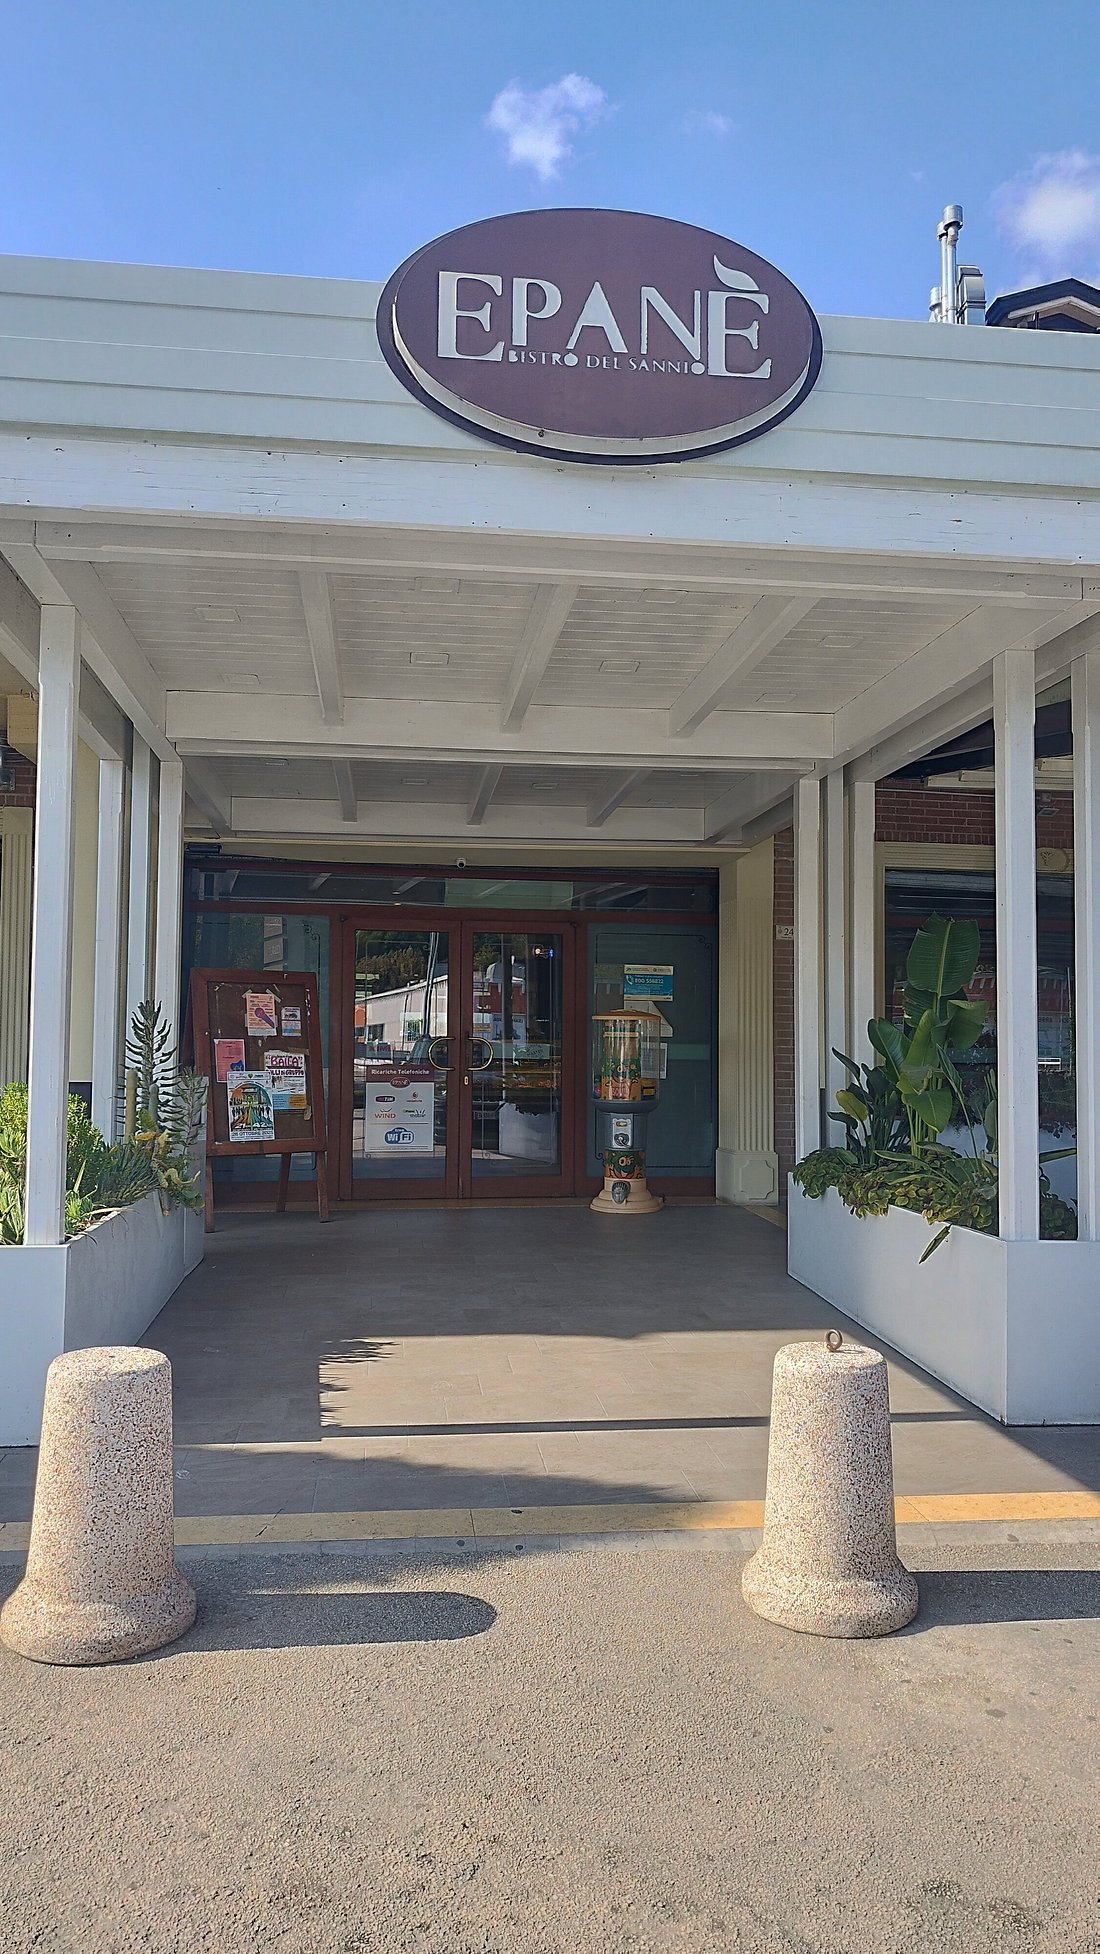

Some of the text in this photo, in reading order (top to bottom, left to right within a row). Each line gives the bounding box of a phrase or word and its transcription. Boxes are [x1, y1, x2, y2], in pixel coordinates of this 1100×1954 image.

[437, 254, 772, 379] EPANÈ
[586, 355, 622, 370] DEL
[628, 358, 706, 376] SANNIO
